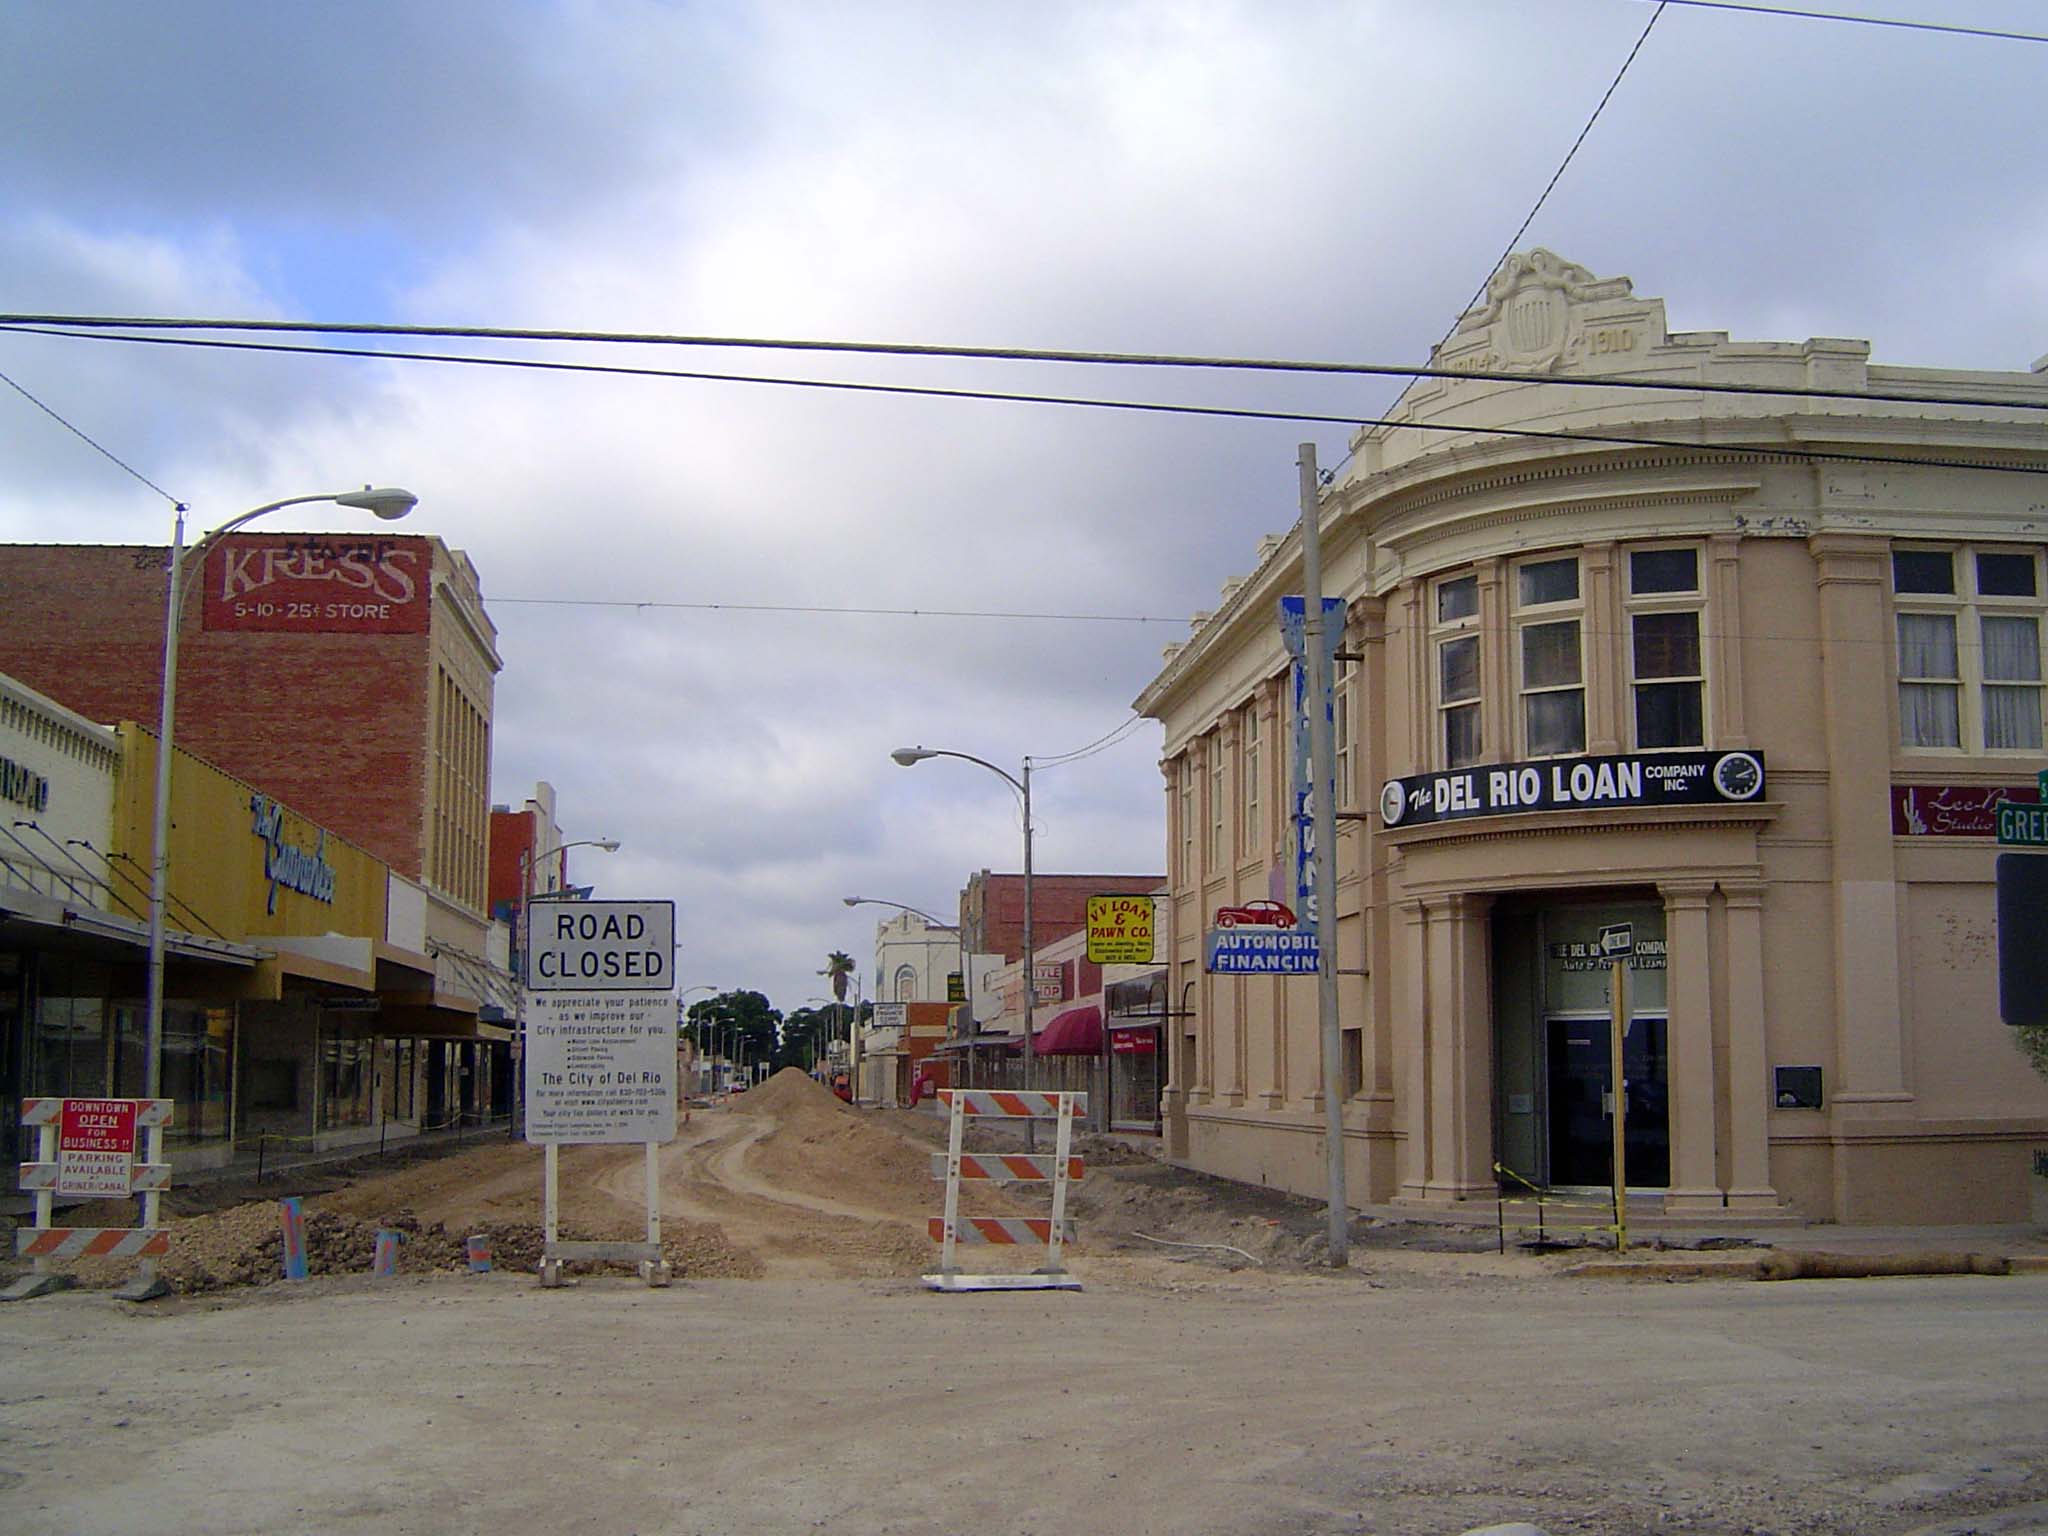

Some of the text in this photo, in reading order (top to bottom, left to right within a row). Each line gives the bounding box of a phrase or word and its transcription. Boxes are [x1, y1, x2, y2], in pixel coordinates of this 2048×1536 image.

[222, 548, 417, 604] KRESS
[325, 603, 391, 619] STORE
[1645, 764, 1706, 778] COMPANY
[1409, 761, 1642, 813] The DEL RIO LOAN
[1664, 779, 1688, 791] INC.
[1112, 901, 1150, 921] LOAN
[1114, 913, 1125, 925] &
[557, 914, 645, 941] ROAD
[1091, 926, 1151, 938] PAWN CO.
[1216, 935, 1320, 949] AUTOMOBIL
[1571, 944, 1586, 957] DEL
[539, 951, 664, 978] CLOSED
[1217, 955, 1320, 969] FINANCIN
[535, 997, 668, 1009] We appreciate your patience
[559, 1012, 644, 1022] as we improve our
[537, 1025, 556, 1036] City
[559, 1024, 625, 1035] infrastructure
[630, 1024, 642, 1034] for
[542, 1071, 661, 1088] The City of Del Rio
[70, 1101, 129, 1113] DOWNTOWN
[80, 1114, 118, 1126] OPEN
[87, 1128, 107, 1136] FOR
[63, 1137, 118, 1149] BUSINESS
[68, 1153, 123, 1164] PARKING
[64, 1165, 127, 1176] AVAILABLE
